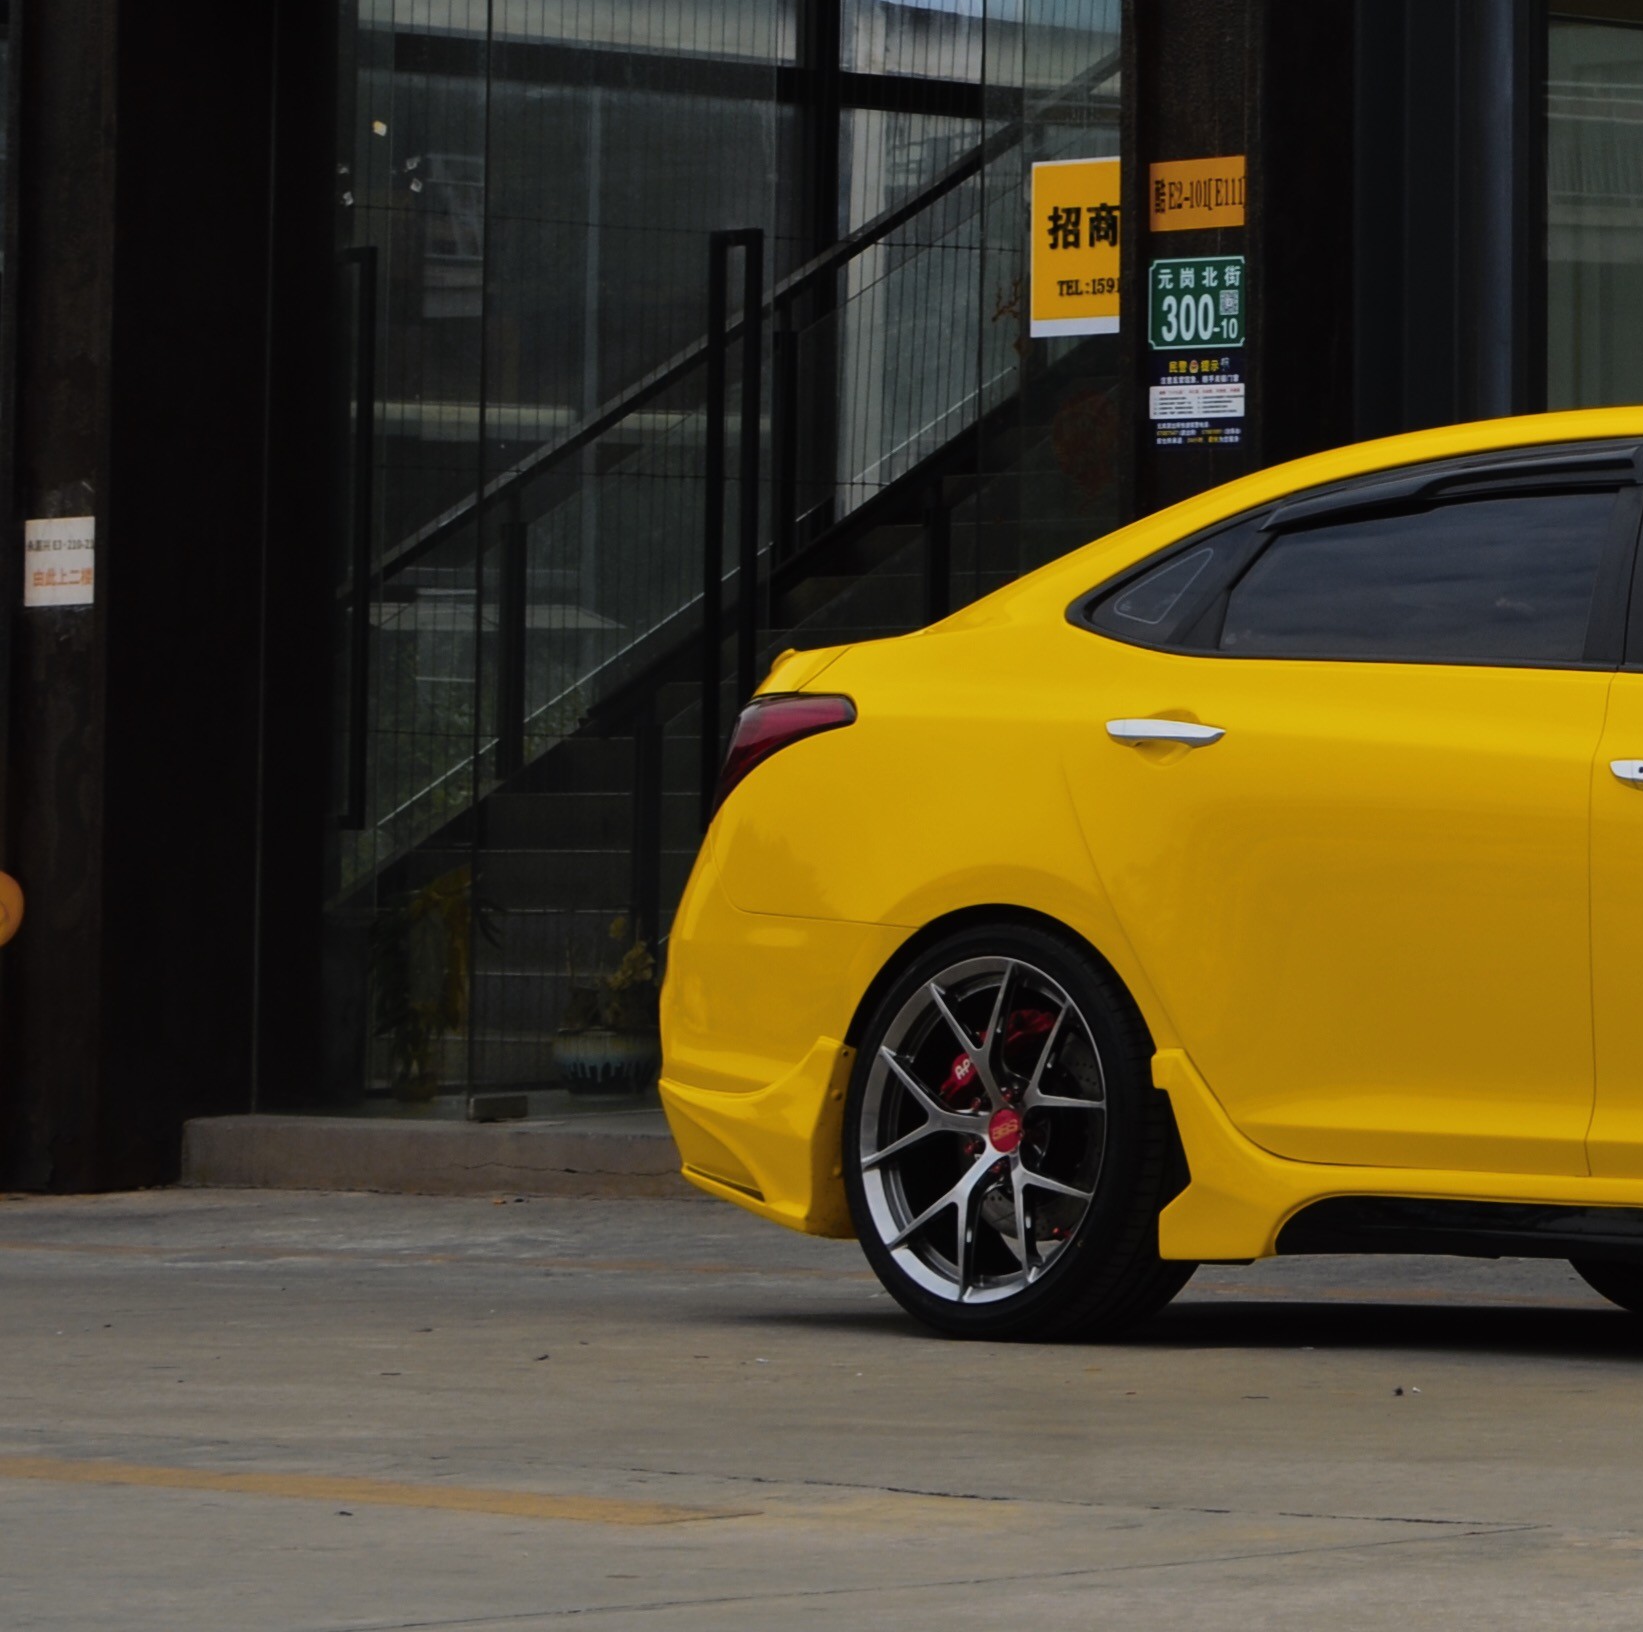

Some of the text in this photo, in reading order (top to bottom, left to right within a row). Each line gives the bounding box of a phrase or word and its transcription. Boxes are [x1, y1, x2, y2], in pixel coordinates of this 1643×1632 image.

[1048, 203, 1121, 250] 招商
[1157, 265, 1242, 290] 元岗北街
